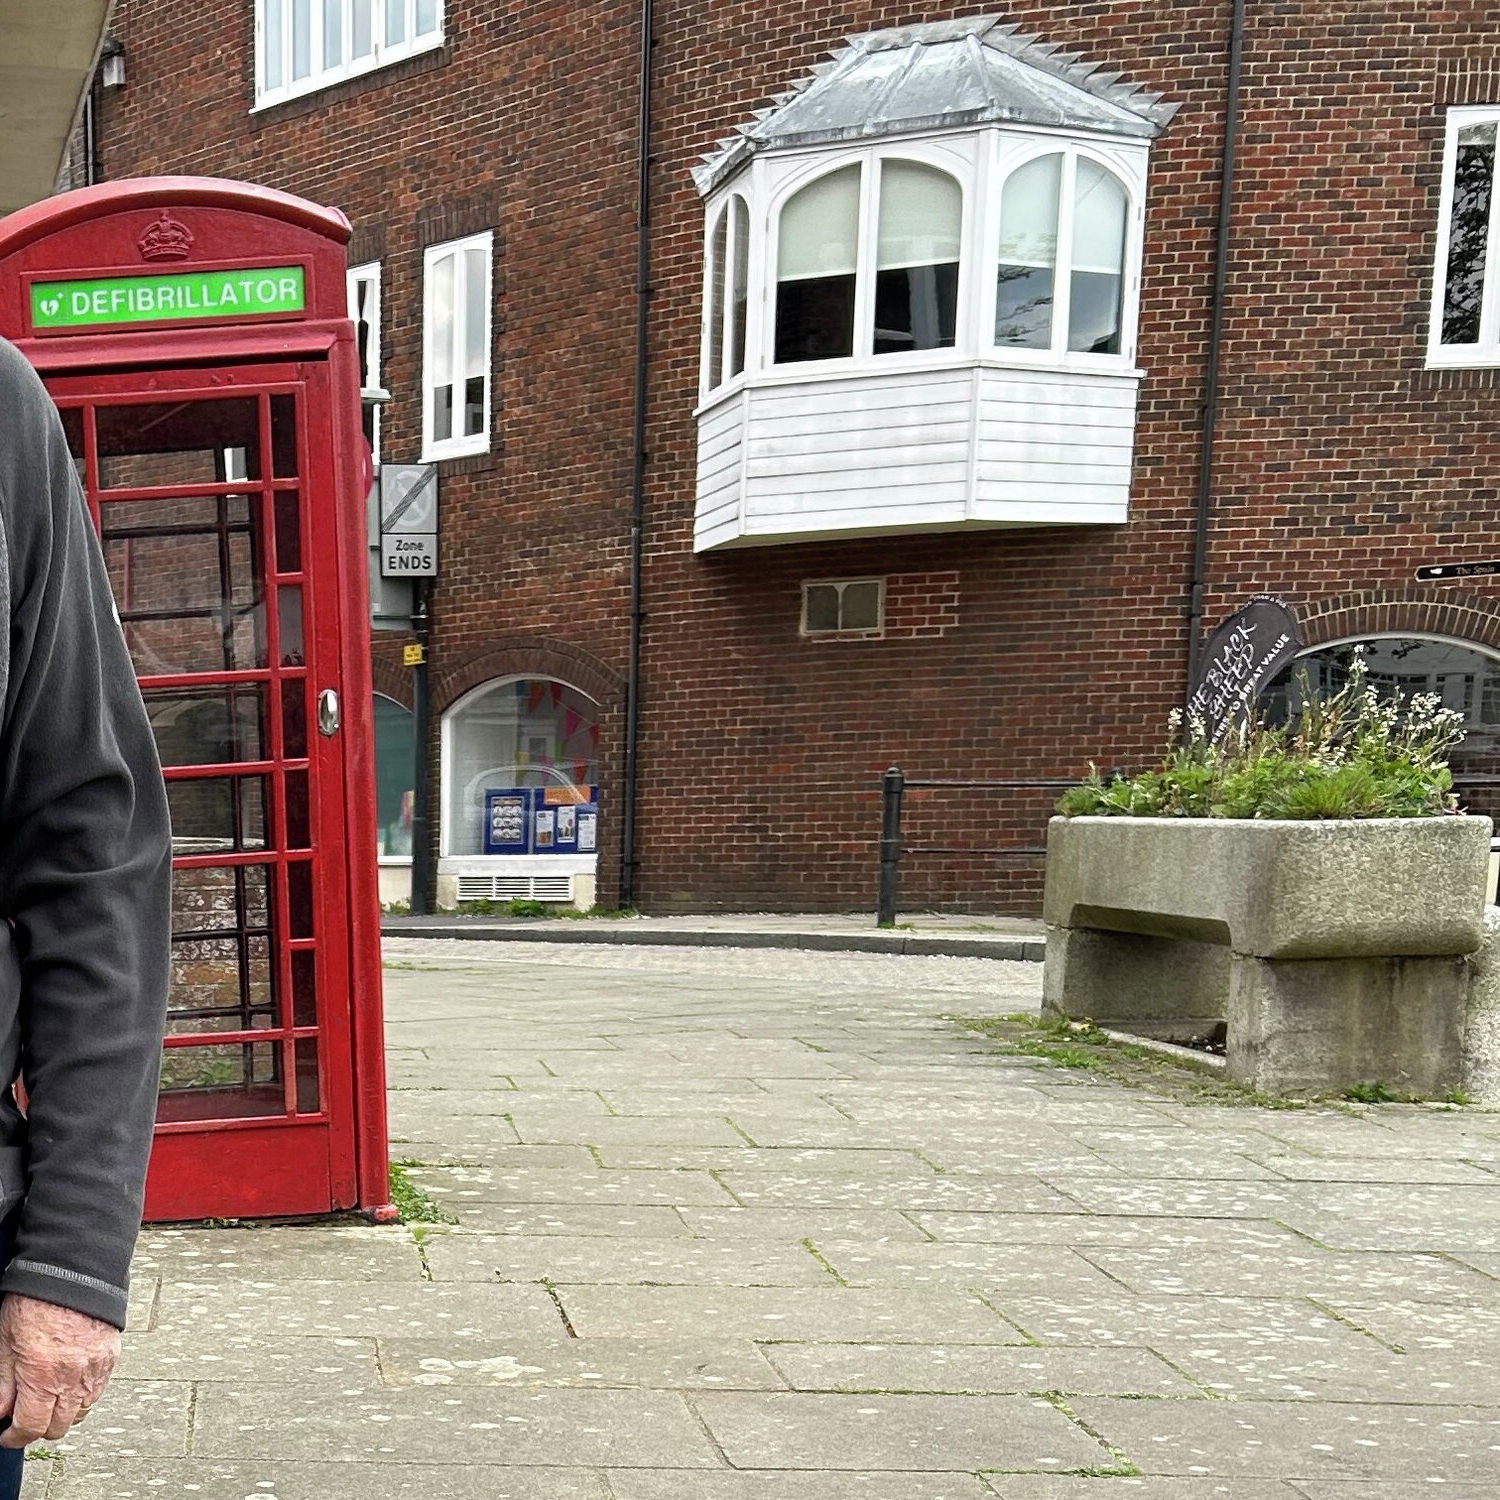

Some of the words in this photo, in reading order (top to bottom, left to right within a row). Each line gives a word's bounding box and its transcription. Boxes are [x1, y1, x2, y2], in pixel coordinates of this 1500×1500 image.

[72, 278, 298, 316] DEFIBRILLATOR
[388, 555, 432, 570] ENDS
[395, 539, 425, 551] Zone
[1206, 617, 1258, 689] BLACK
[1260, 633, 1291, 667] VALUE
[1209, 643, 1255, 720] SHEEP
